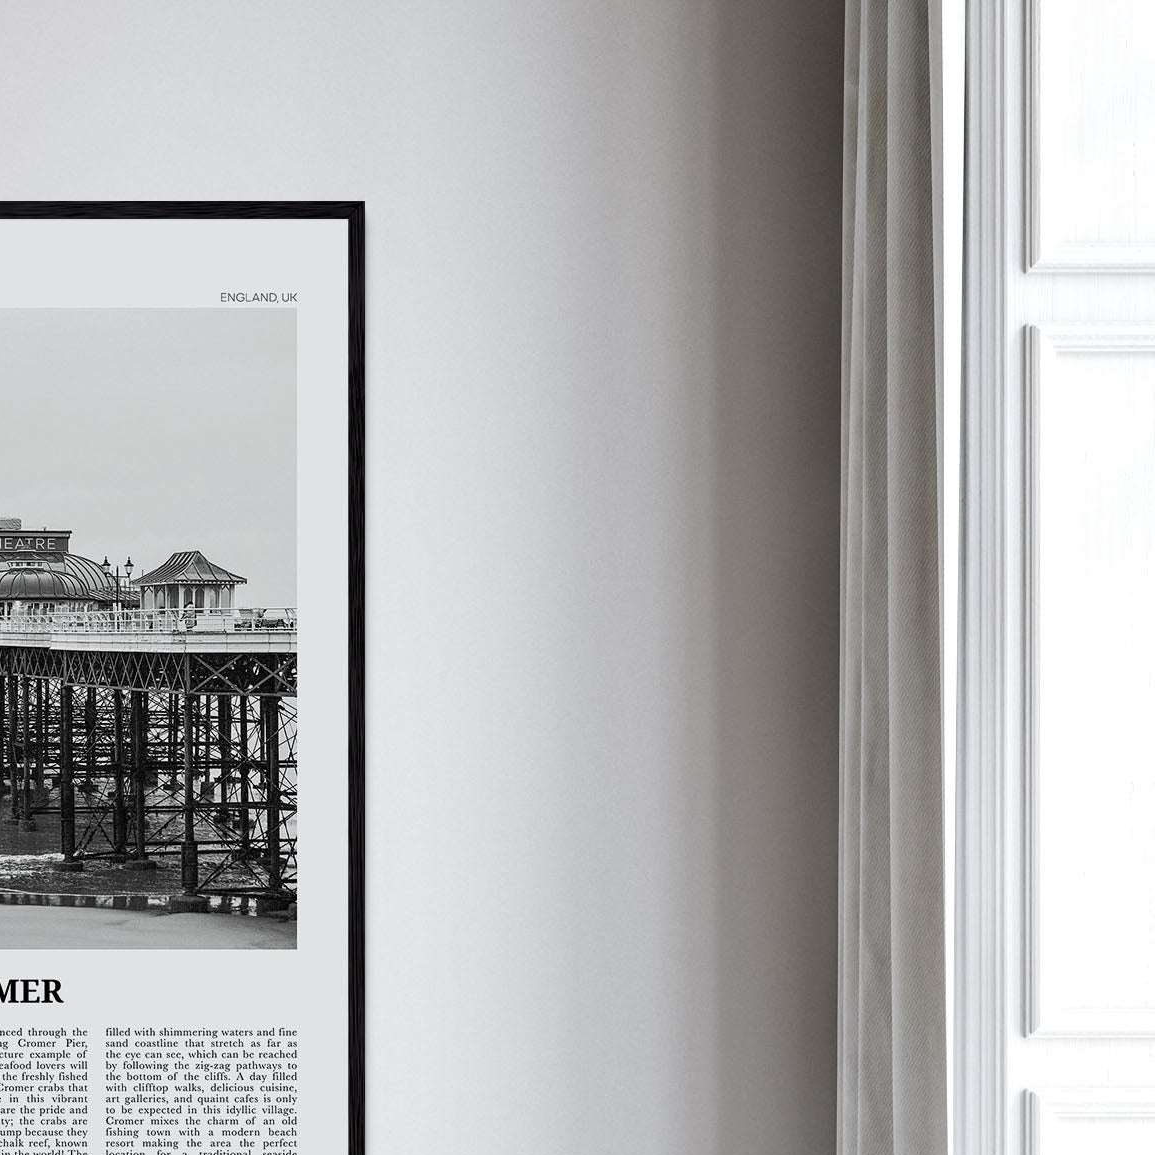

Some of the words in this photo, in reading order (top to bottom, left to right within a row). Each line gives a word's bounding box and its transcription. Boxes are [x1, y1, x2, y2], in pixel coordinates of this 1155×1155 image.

[220, 292, 280, 304] ENGLAND,
[281, 292, 298, 303] UK
[27, 1028, 67, 1039] through
[72, 1028, 88, 1036] the
[105, 1028, 131, 1036] filled
[134, 1028, 156, 1036] with
[158, 1028, 219, 1039] shimmering
[256, 1028, 275, 1036] and
[278, 1028, 298, 1036] fine
[17, 1039, 57, 1047] Cromer
[66, 1039, 88, 1049] Pier,
[105, 1039, 129, 1047] sand
[134, 1039, 179, 1047] coastline
[184, 1039, 205, 1047] that
[210, 1039, 244, 1047] stretch
[267, 1039, 282, 1047] far
[36, 1061, 66, 1070] lovers
[69, 1061, 88, 1070] will
[105, 1061, 118, 1072] by
[123, 1061, 169, 1072] following
[174, 1061, 190, 1070] the
[195, 1061, 231, 1072] zig-zag
[235, 1061, 283, 1072] pathways
[287, 1062, 298, 1070] to
[2, 1072, 18, 1081] the
[21, 1072, 55, 1083] freshly
[58, 1072, 88, 1081] fished
[105, 1072, 122, 1081] the
[126, 1072, 162, 1081] bottom
[167, 1072, 178, 1081] of
[183, 1072, 200, 1081] the
[204, 1072, 231, 1081] cliffs.
[236, 1072, 245, 1081] A
[249, 1072, 268, 1083] day
[272, 1072, 298, 1081] filled
[37, 1083, 65, 1092] crabs
[68, 1083, 88, 1092] that
[105, 1083, 127, 1092] with
[132, 1083, 169, 1094] clifftop
[174, 1083, 205, 1093] walks,
[210, 1083, 255, 1092] delicious
[259, 1083, 298, 1093] cuisine,
[25, 1127, 64, 1136] because
[66, 1127, 88, 1139] they
[105, 1127, 139, 1139] fishing
[178, 1127, 201, 1136] with
[221, 1127, 261, 1136] modern
[268, 1127, 297, 1136] beach
